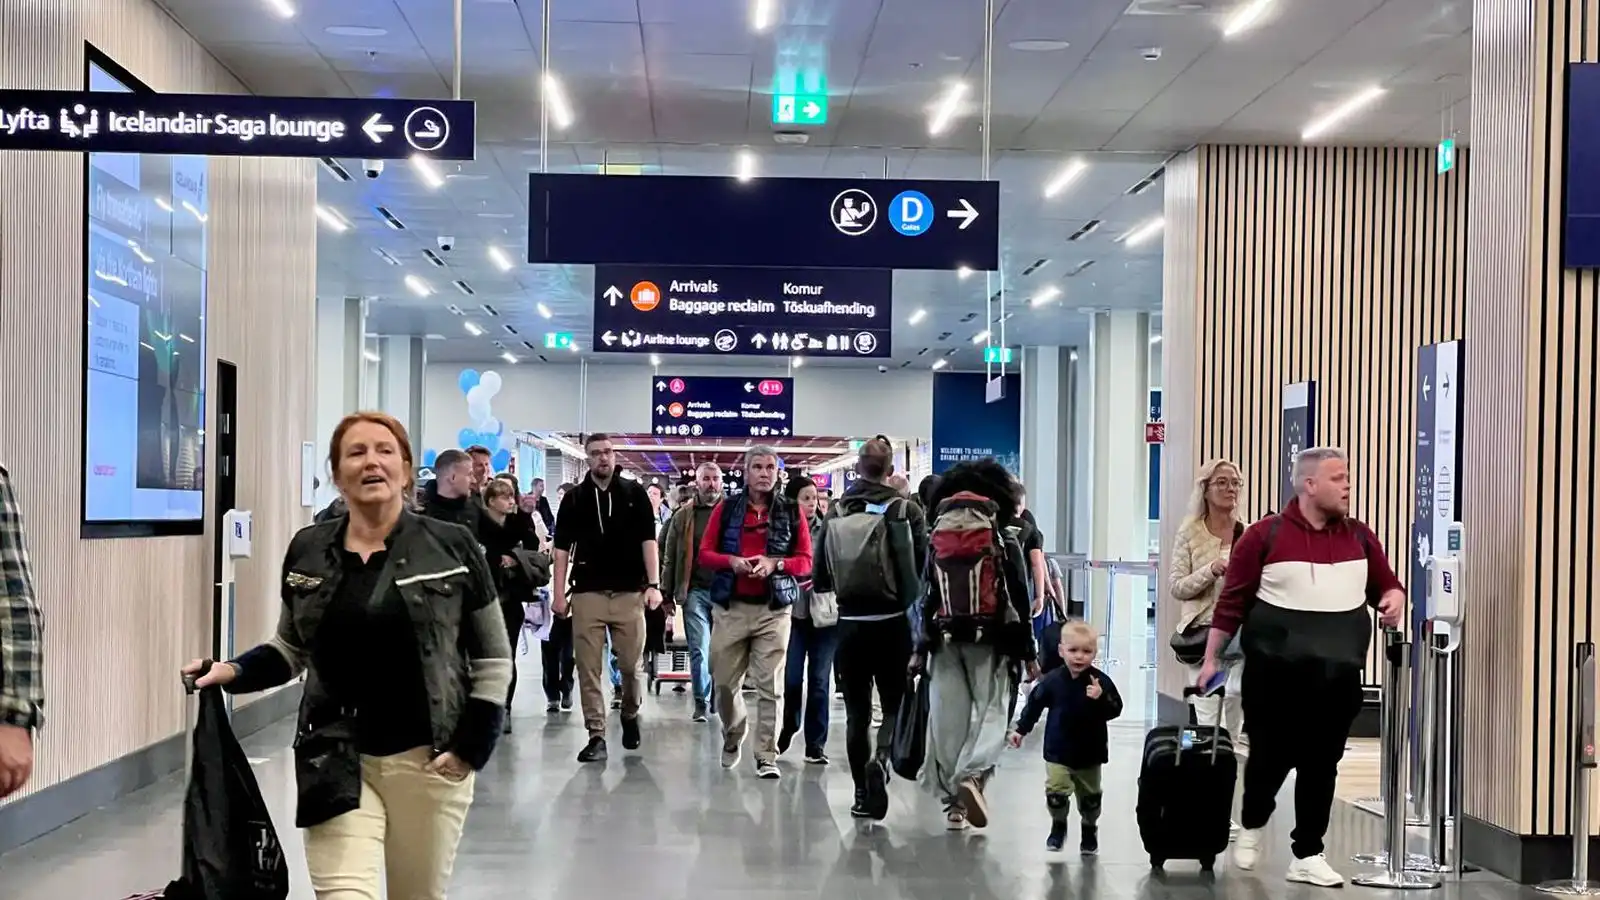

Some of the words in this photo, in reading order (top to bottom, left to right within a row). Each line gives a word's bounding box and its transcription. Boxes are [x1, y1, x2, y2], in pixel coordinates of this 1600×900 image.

[0, 107, 50, 135] Lyfta
[109, 110, 213, 134] Icelandair
[214, 113, 266, 141] Saga
[270, 113, 345, 142] lounge
[902, 196, 923, 222] D
[901, 223, 920, 231] Gates
[669, 280, 718, 293] Arrivals
[783, 282, 823, 295] Komur
[669, 298, 725, 314] Baggage
[727, 299, 775, 313] reclaim
[783, 300, 875, 318] Töskuafhending
[643, 334, 675, 345] Airline
[676, 334, 710, 347] lounge
